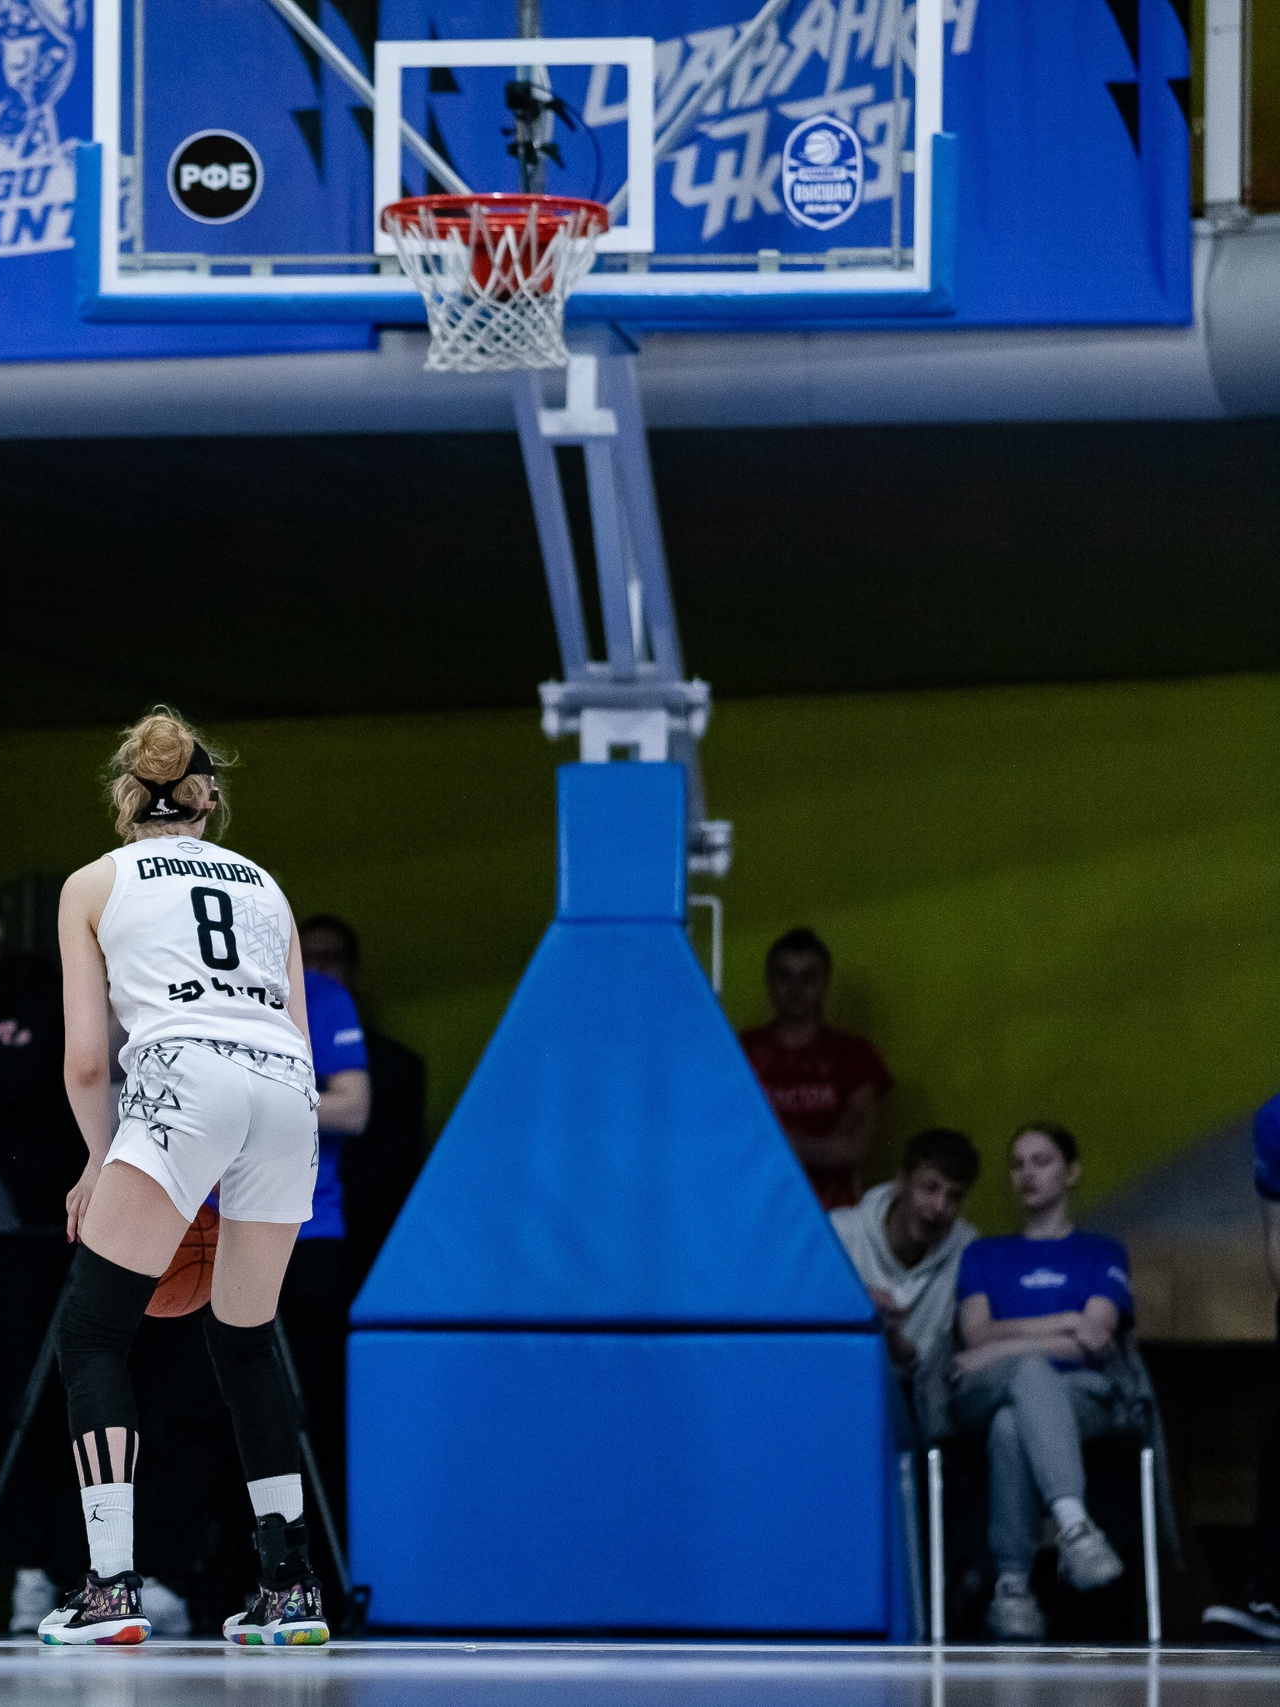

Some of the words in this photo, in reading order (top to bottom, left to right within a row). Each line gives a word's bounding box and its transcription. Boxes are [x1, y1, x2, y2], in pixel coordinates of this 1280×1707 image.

[179, 162, 252, 191] РФБ
[136, 856, 264, 888] САФОНОВА
[190, 886, 240, 971] 8
